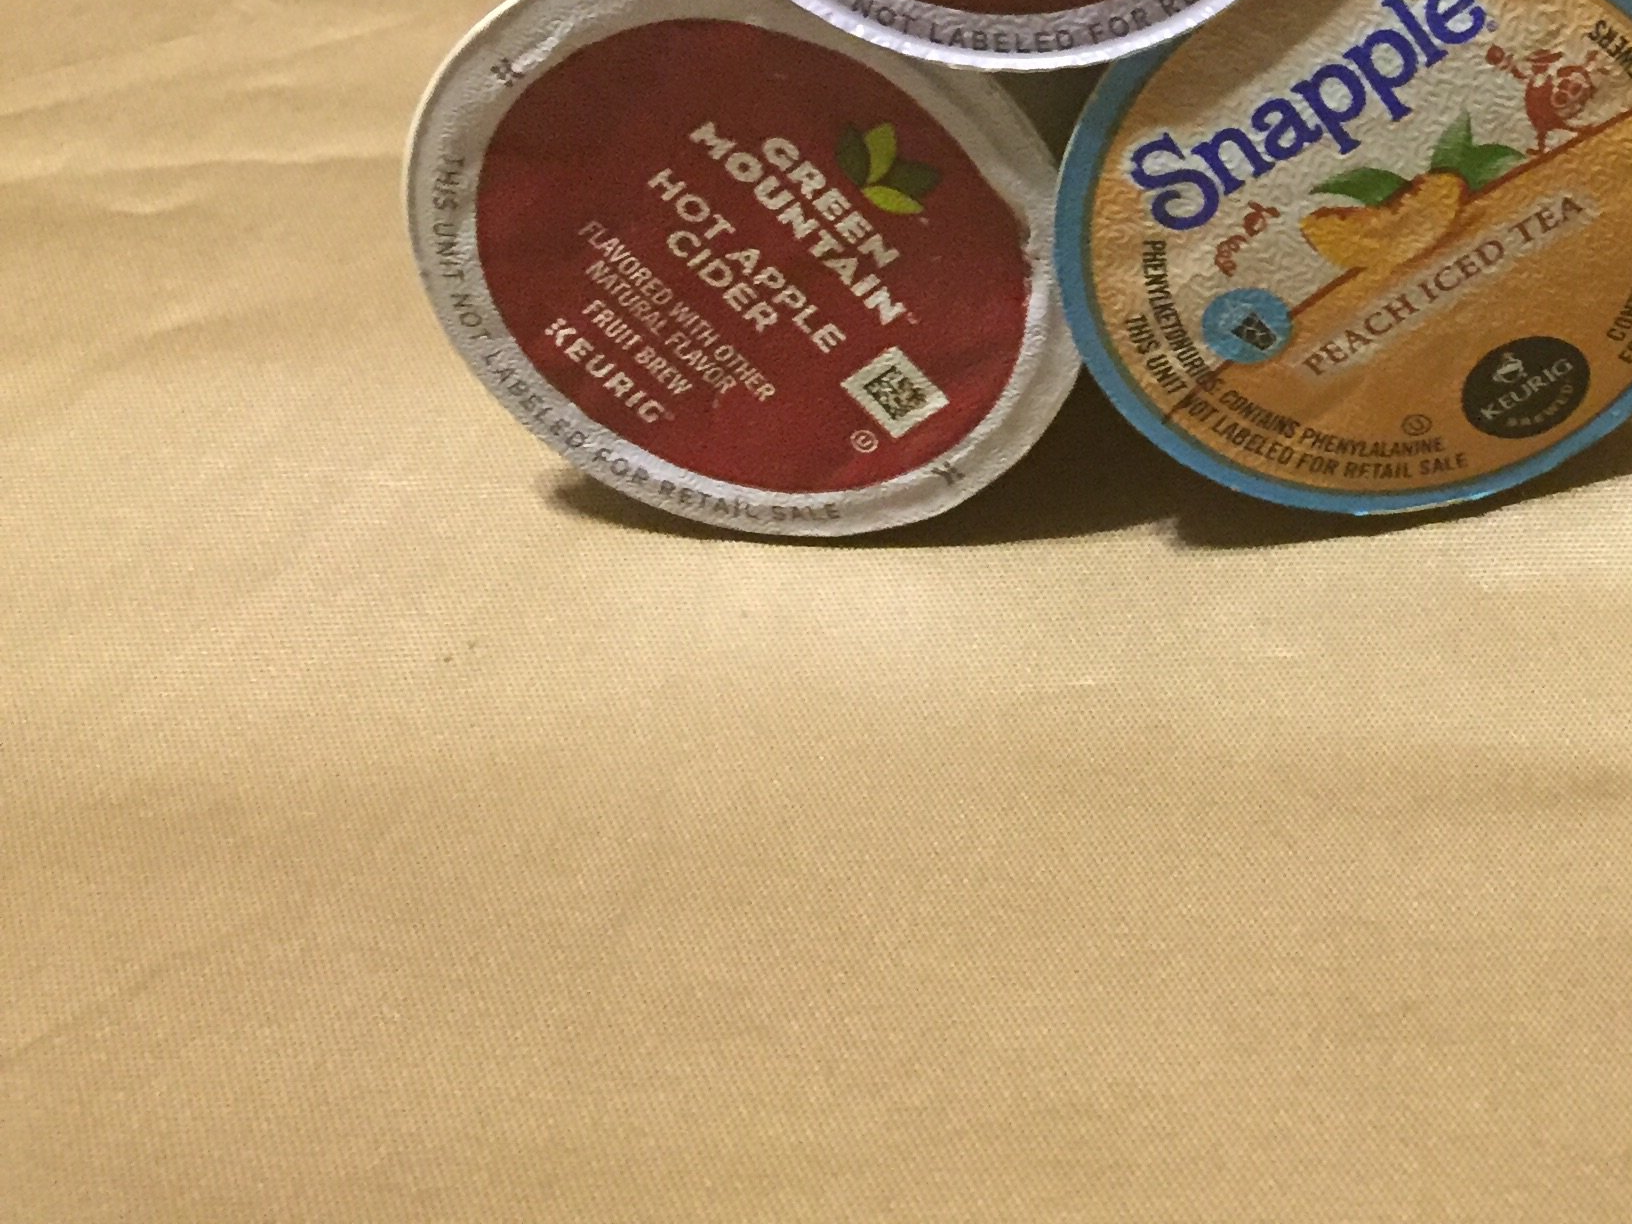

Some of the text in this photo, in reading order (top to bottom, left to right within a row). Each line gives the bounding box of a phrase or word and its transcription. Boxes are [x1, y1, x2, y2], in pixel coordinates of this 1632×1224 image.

[929, 22, 1073, 54] LABELED
[1089, 6, 1150, 46] FOR
[648, 168, 847, 354] HOT APPLE
[688, 121, 908, 326] MOUNTAIN
[762, 137, 899, 268] GREEN
[432, 157, 841, 522] THIS UNIT NOT LABELED FOR RETAIL SALE
[578, 221, 777, 402] FLAVORED WITH OTHER
[581, 299, 693, 396] FRUIT BREW
[585, 260, 737, 395] NATURAL FLAVOR
[666, 230, 778, 333] CIDER
[1302, 197, 1584, 376] PEACH ICED TEA
[544, 317, 665, 424] KEURIG
[1124, 314, 1162, 355] THIS
[1146, 353, 1188, 395] UNIT
[1211, 414, 1296, 464] LABELED
[1296, 452, 1340, 477] FOR
[1342, 460, 1413, 479] RETAIL
[1419, 452, 1469, 476] SALE
[1219, 389, 1301, 439] CONTAINS
[1300, 426, 1447, 458] PHENYLALANINE
[1479, 358, 1574, 421] KEURIG
